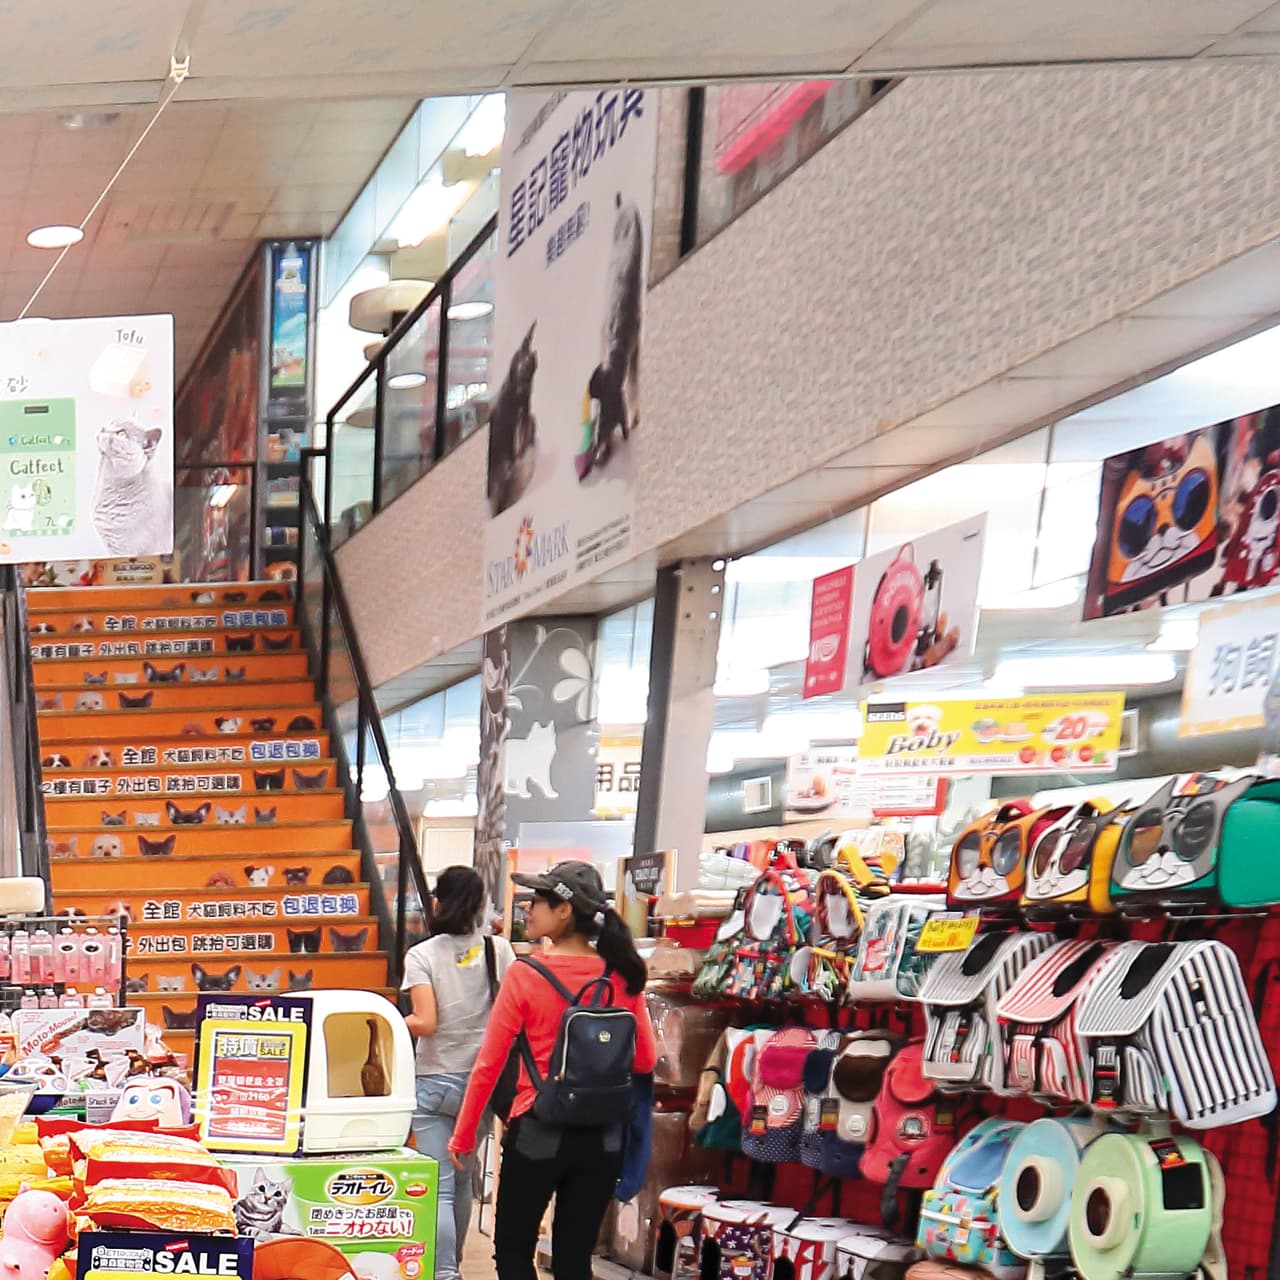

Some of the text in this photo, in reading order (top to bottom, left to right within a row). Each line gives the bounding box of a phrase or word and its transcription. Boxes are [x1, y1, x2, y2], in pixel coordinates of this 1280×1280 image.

[116, 328, 144, 345] Tofu
[1055, 717, 1086, 740] 20
[885, 729, 962, 757] Baby
[122, 748, 157, 766] 全館
[116, 775, 161, 793] 外出包
[143, 902, 182, 921] 全館
[283, 893, 359, 915] 包退包換
[138, 936, 187, 953] 外出包
[247, 1006, 305, 1023] SALE
[220, 1037, 258, 1057] 特價
[260, 1048, 285, 1057] SALE
[330, 1181, 393, 1196] デオトイレ
[311, 1207, 412, 1220] 閉めきったお部屋でも
[154, 1250, 239, 1276] SALE
